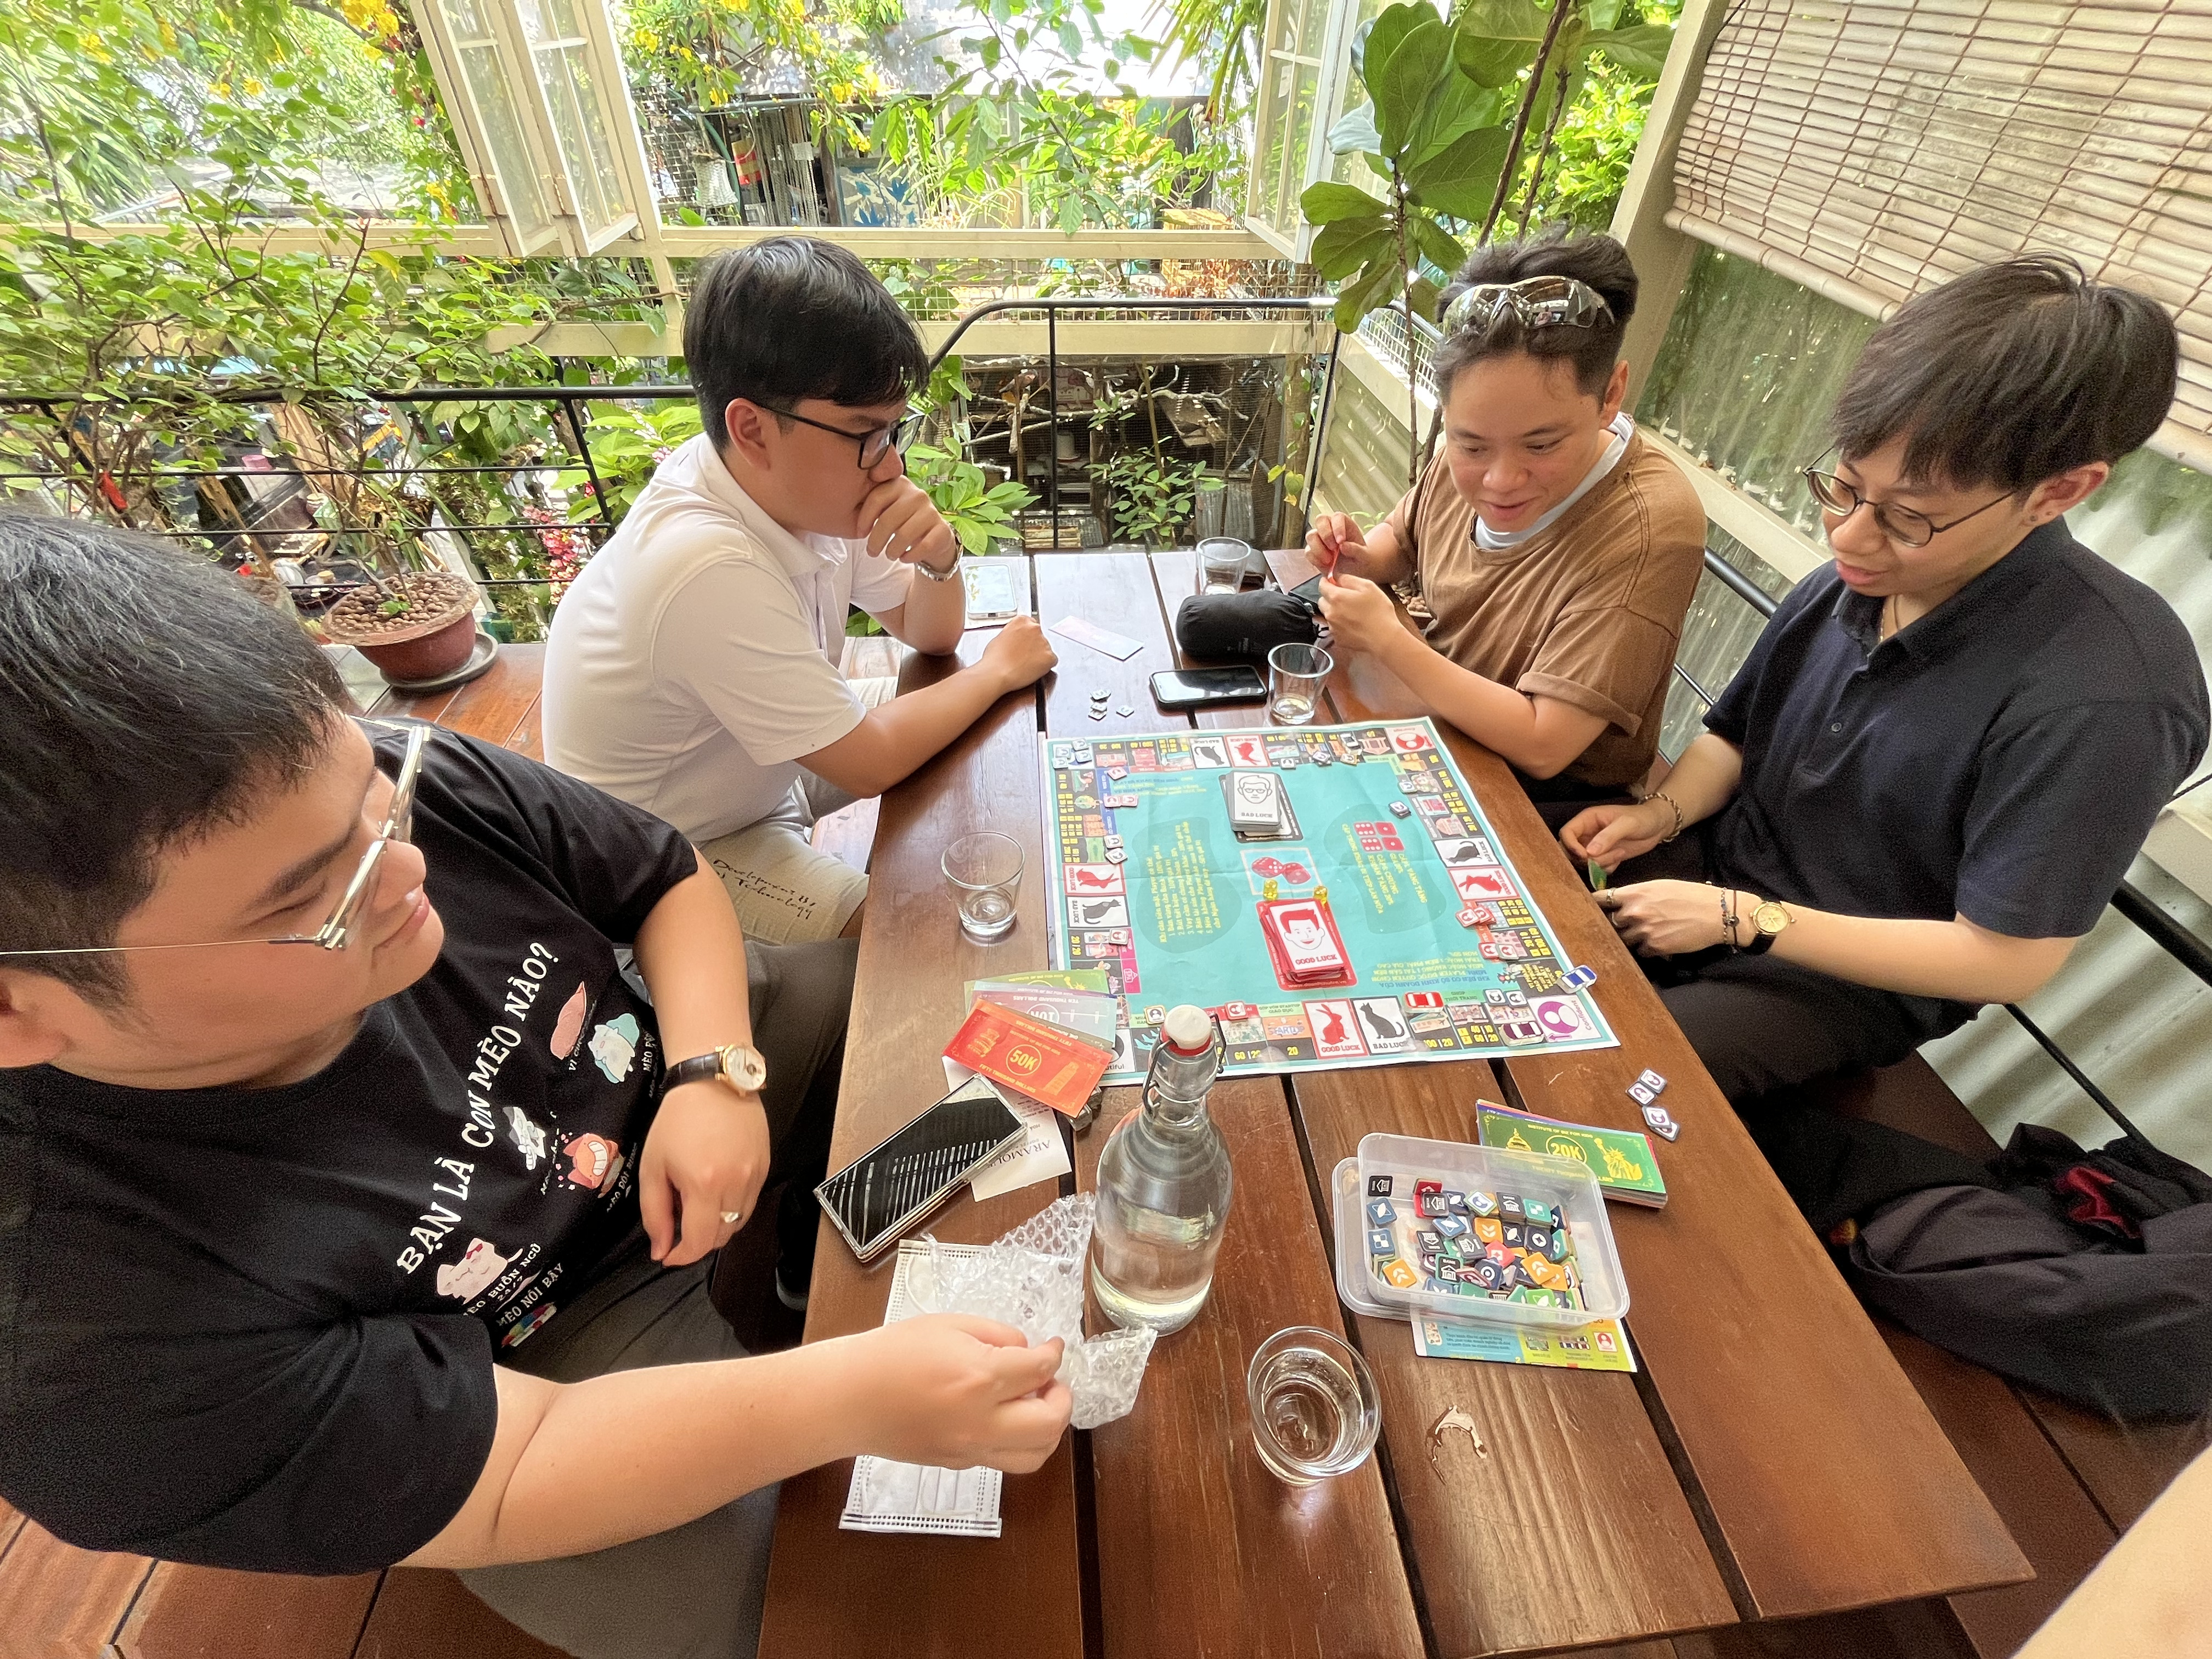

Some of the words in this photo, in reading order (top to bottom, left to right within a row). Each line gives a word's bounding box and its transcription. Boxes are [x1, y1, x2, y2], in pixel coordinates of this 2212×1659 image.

[1295, 956, 1315, 964] GOOD
[1316, 954, 1338, 962] LUCK
[504, 942, 560, 1022] NÀO?
[1014, 1019, 1036, 1031] DOLLARS
[1571, 1000, 1592, 1030] Confident
[1034, 1028, 1059, 1041] THOUSAND
[1058, 1037, 1072, 1046] FIFTY
[1442, 1039, 1454, 1047] 20
[467, 1025, 522, 1092] MÈO
[1010, 1049, 1038, 1070] 50K
[1288, 1047, 1299, 1056] 20
[979, 1063, 993, 1073] FIFTY
[992, 1069, 1015, 1084] THOUSAND
[1015, 1080, 1036, 1093] DOLLARS
[461, 1089, 496, 1149] CON
[1551, 1143, 1583, 1160] 20K
[432, 1156, 475, 1201] LÀ
[397, 1201, 463, 1275] BẠN
